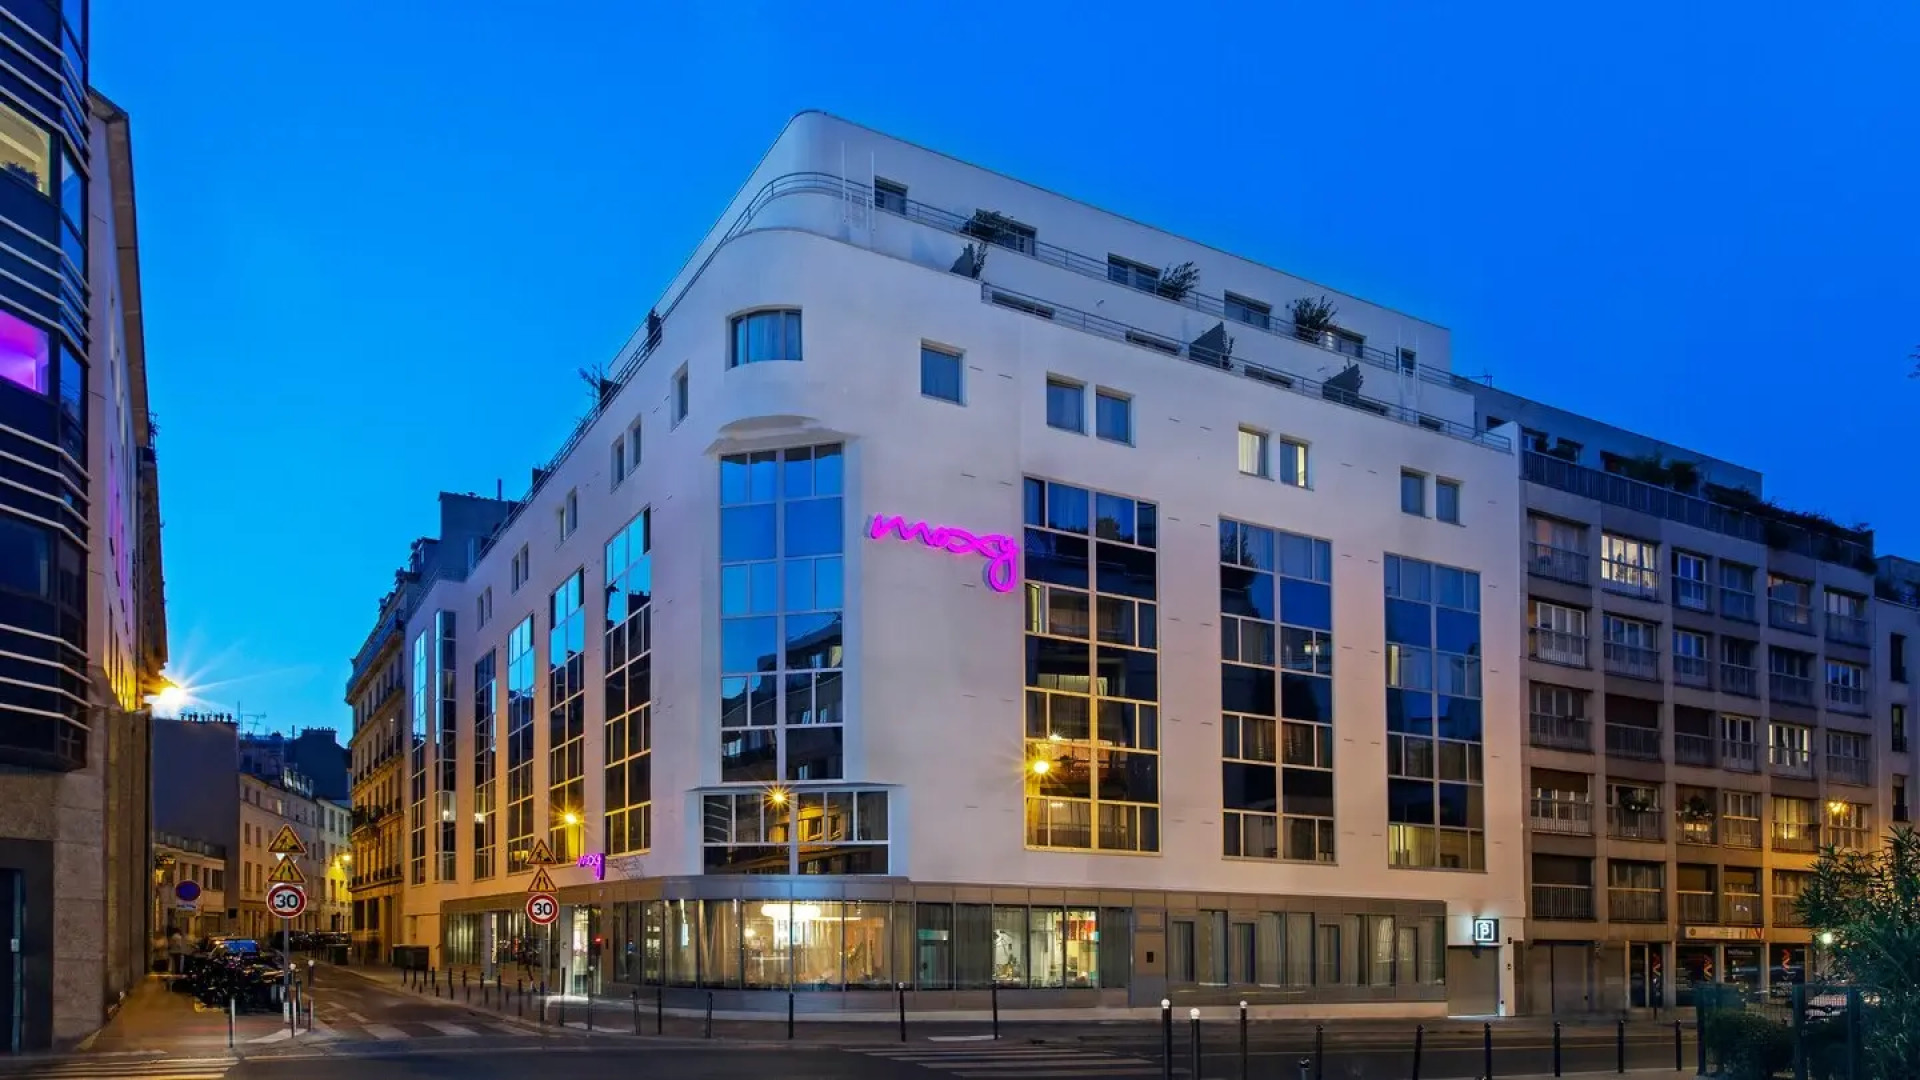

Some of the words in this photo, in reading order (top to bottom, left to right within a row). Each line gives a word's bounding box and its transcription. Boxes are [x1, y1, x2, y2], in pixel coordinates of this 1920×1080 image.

[870, 513, 1018, 593] moxy
[275, 894, 298, 909] 30
[534, 902, 553, 916] 30
